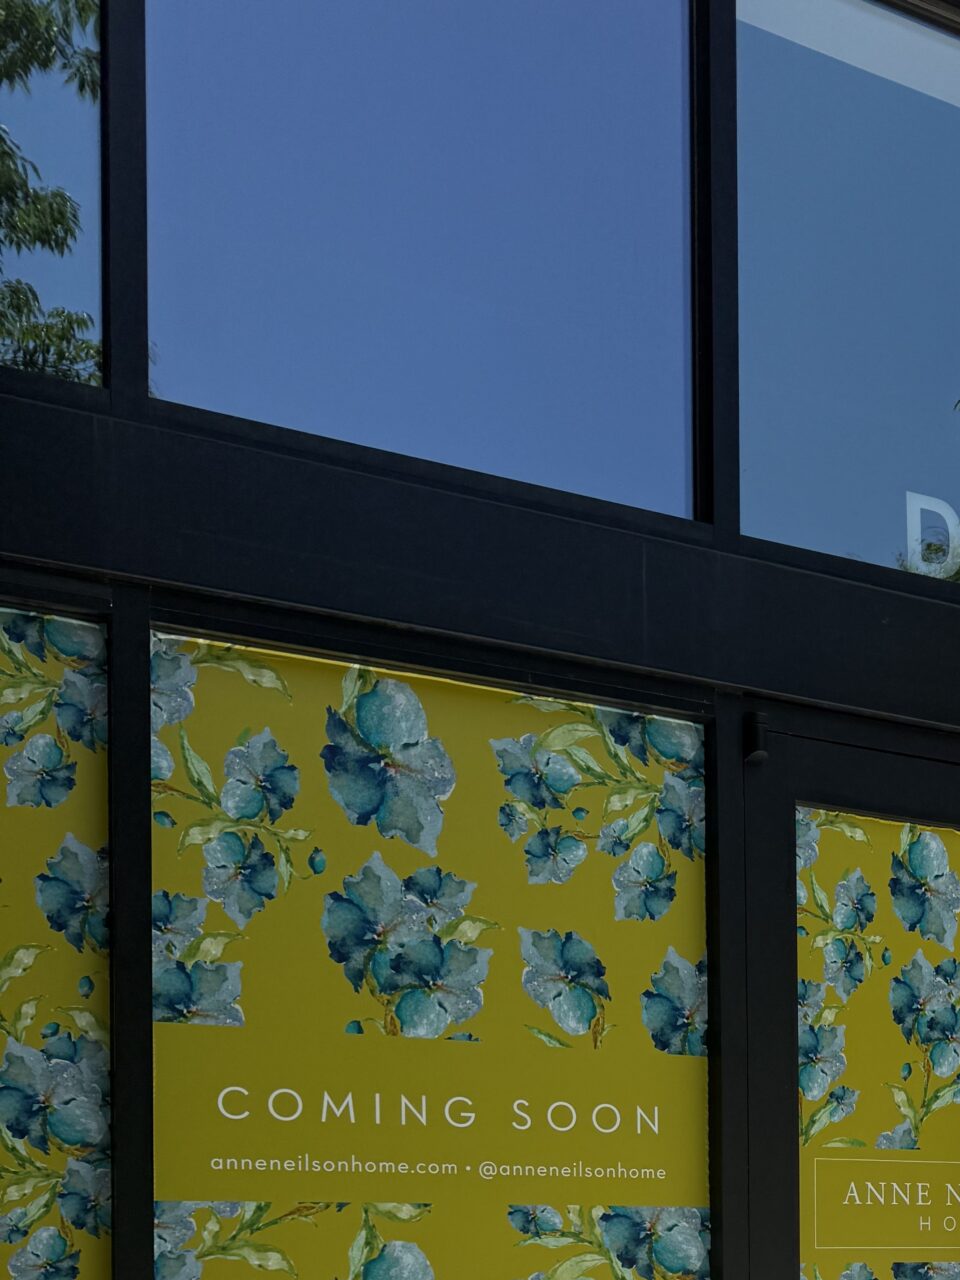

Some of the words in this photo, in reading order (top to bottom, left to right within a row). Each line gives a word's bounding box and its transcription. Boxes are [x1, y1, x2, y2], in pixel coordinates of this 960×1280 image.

[216, 1086, 477, 1128] COMING
[511, 1098, 659, 1135] SOON
[210, 1152, 458, 1175] anneneilsonhome.com
[478, 1160, 667, 1180] @anneneilsonhome
[842, 1181, 932, 1206] ANNE
